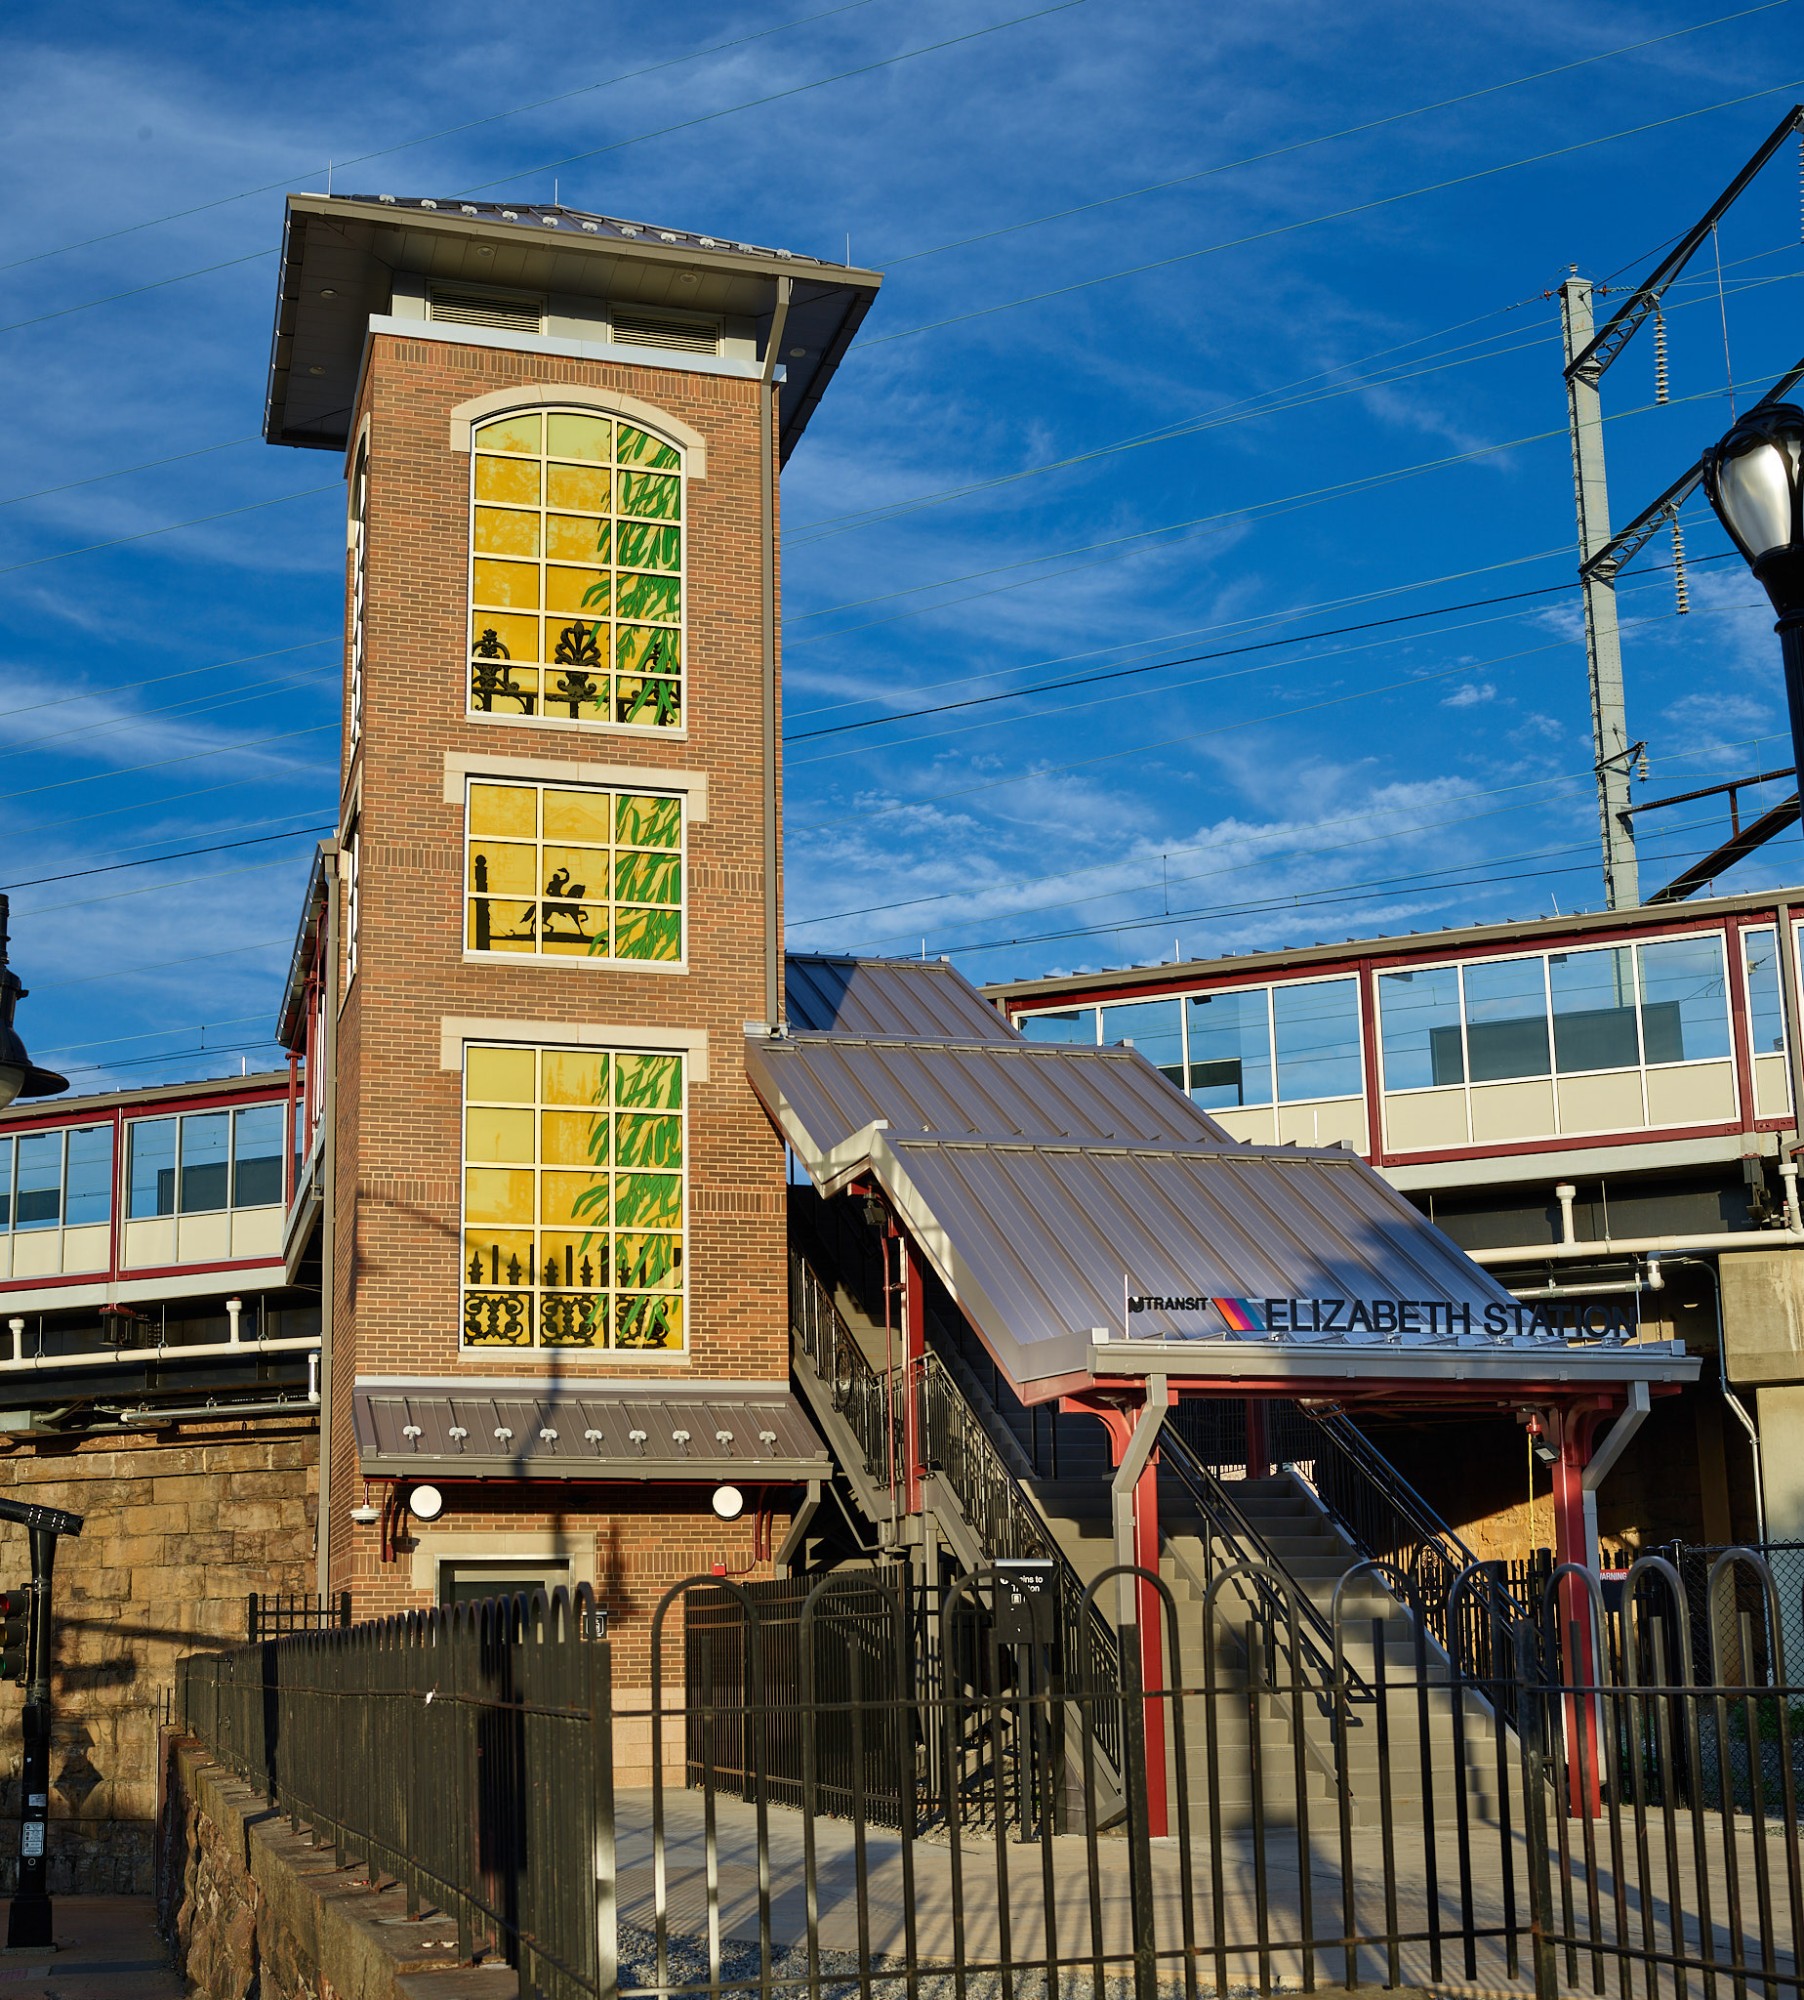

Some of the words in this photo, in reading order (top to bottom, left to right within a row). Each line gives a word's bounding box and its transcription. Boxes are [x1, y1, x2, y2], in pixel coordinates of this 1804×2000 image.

[1143, 1297, 1208, 1311] TRANSIT
[1265, 1298, 1471, 1335] ELIZABETH
[1483, 1302, 1638, 1338] STATION
[1034, 1575, 1044, 1584] to
